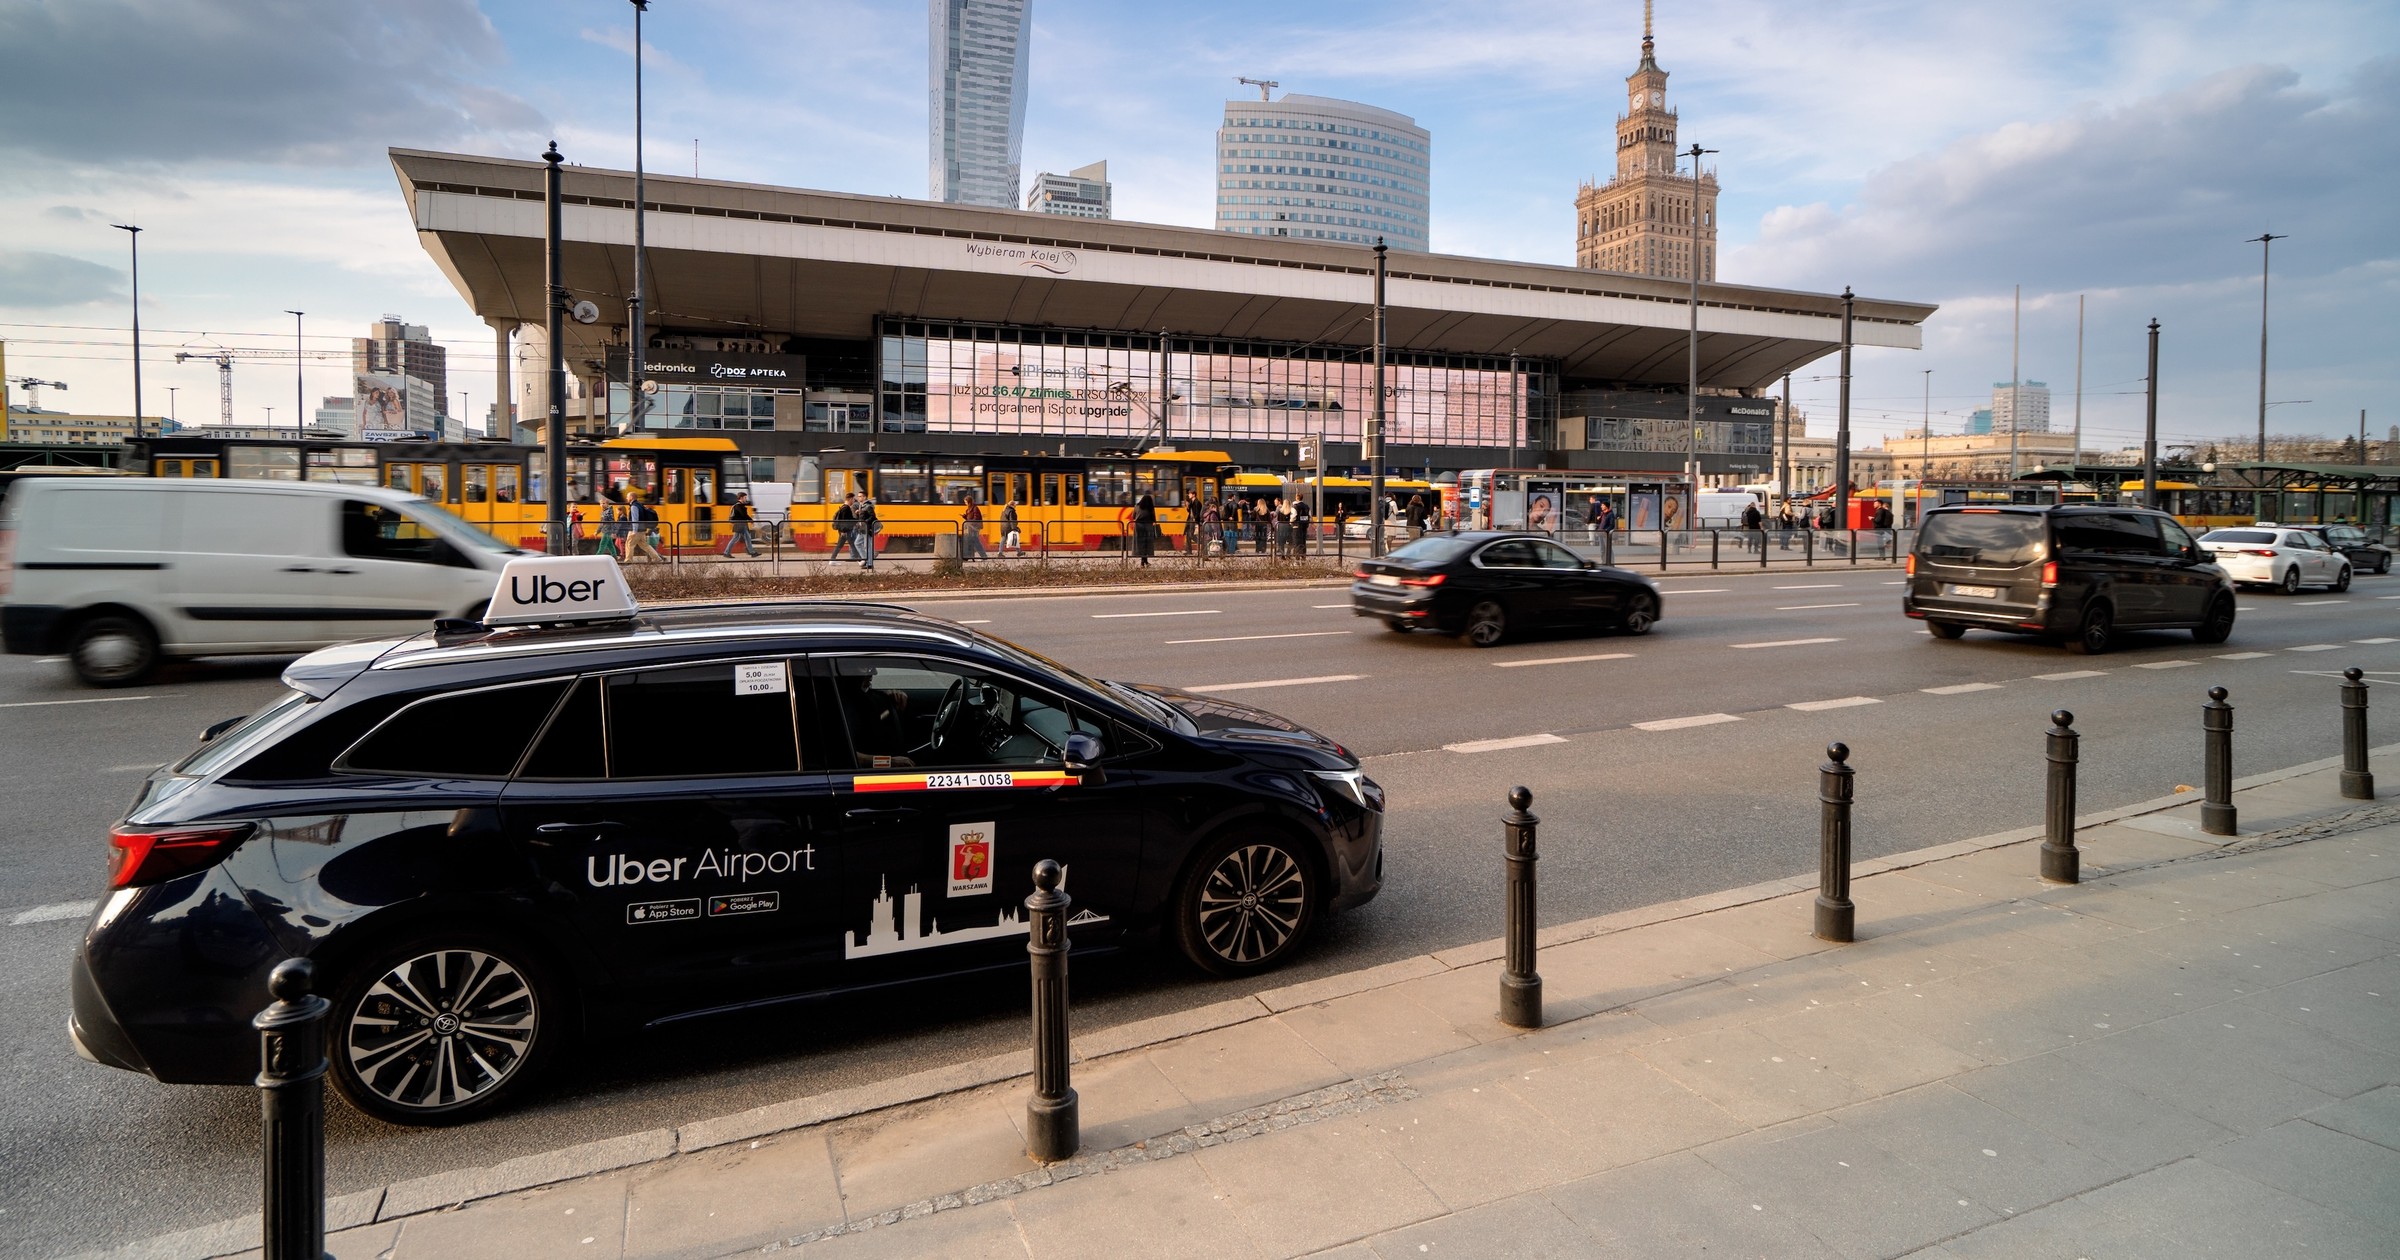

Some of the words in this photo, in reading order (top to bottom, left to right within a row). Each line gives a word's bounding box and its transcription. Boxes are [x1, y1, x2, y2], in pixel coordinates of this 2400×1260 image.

[966, 243, 1026, 258] Wybieram
[1030, 249, 1060, 263] Kolej
[643, 361, 696, 373] iedronka
[726, 367, 747, 376] DOZ
[750, 368, 787, 378] APTEKA
[1023, 364, 1070, 378] iPhone
[954, 383, 970, 397] już
[974, 385, 989, 396] od
[1076, 388, 1108, 400] RRSO
[1369, 381, 1407, 401] ipot
[1731, 407, 1770, 416] McDonald's
[512, 575, 605, 605] Uber
[928, 774, 1012, 787] 22341-0058
[587, 853, 687, 888] Uber
[693, 843, 816, 883] Airport
[952, 882, 988, 892] WARSZAWA
[730, 901, 757, 911] Google
[648, 909, 668, 919] App
[669, 907, 695, 916] Store
